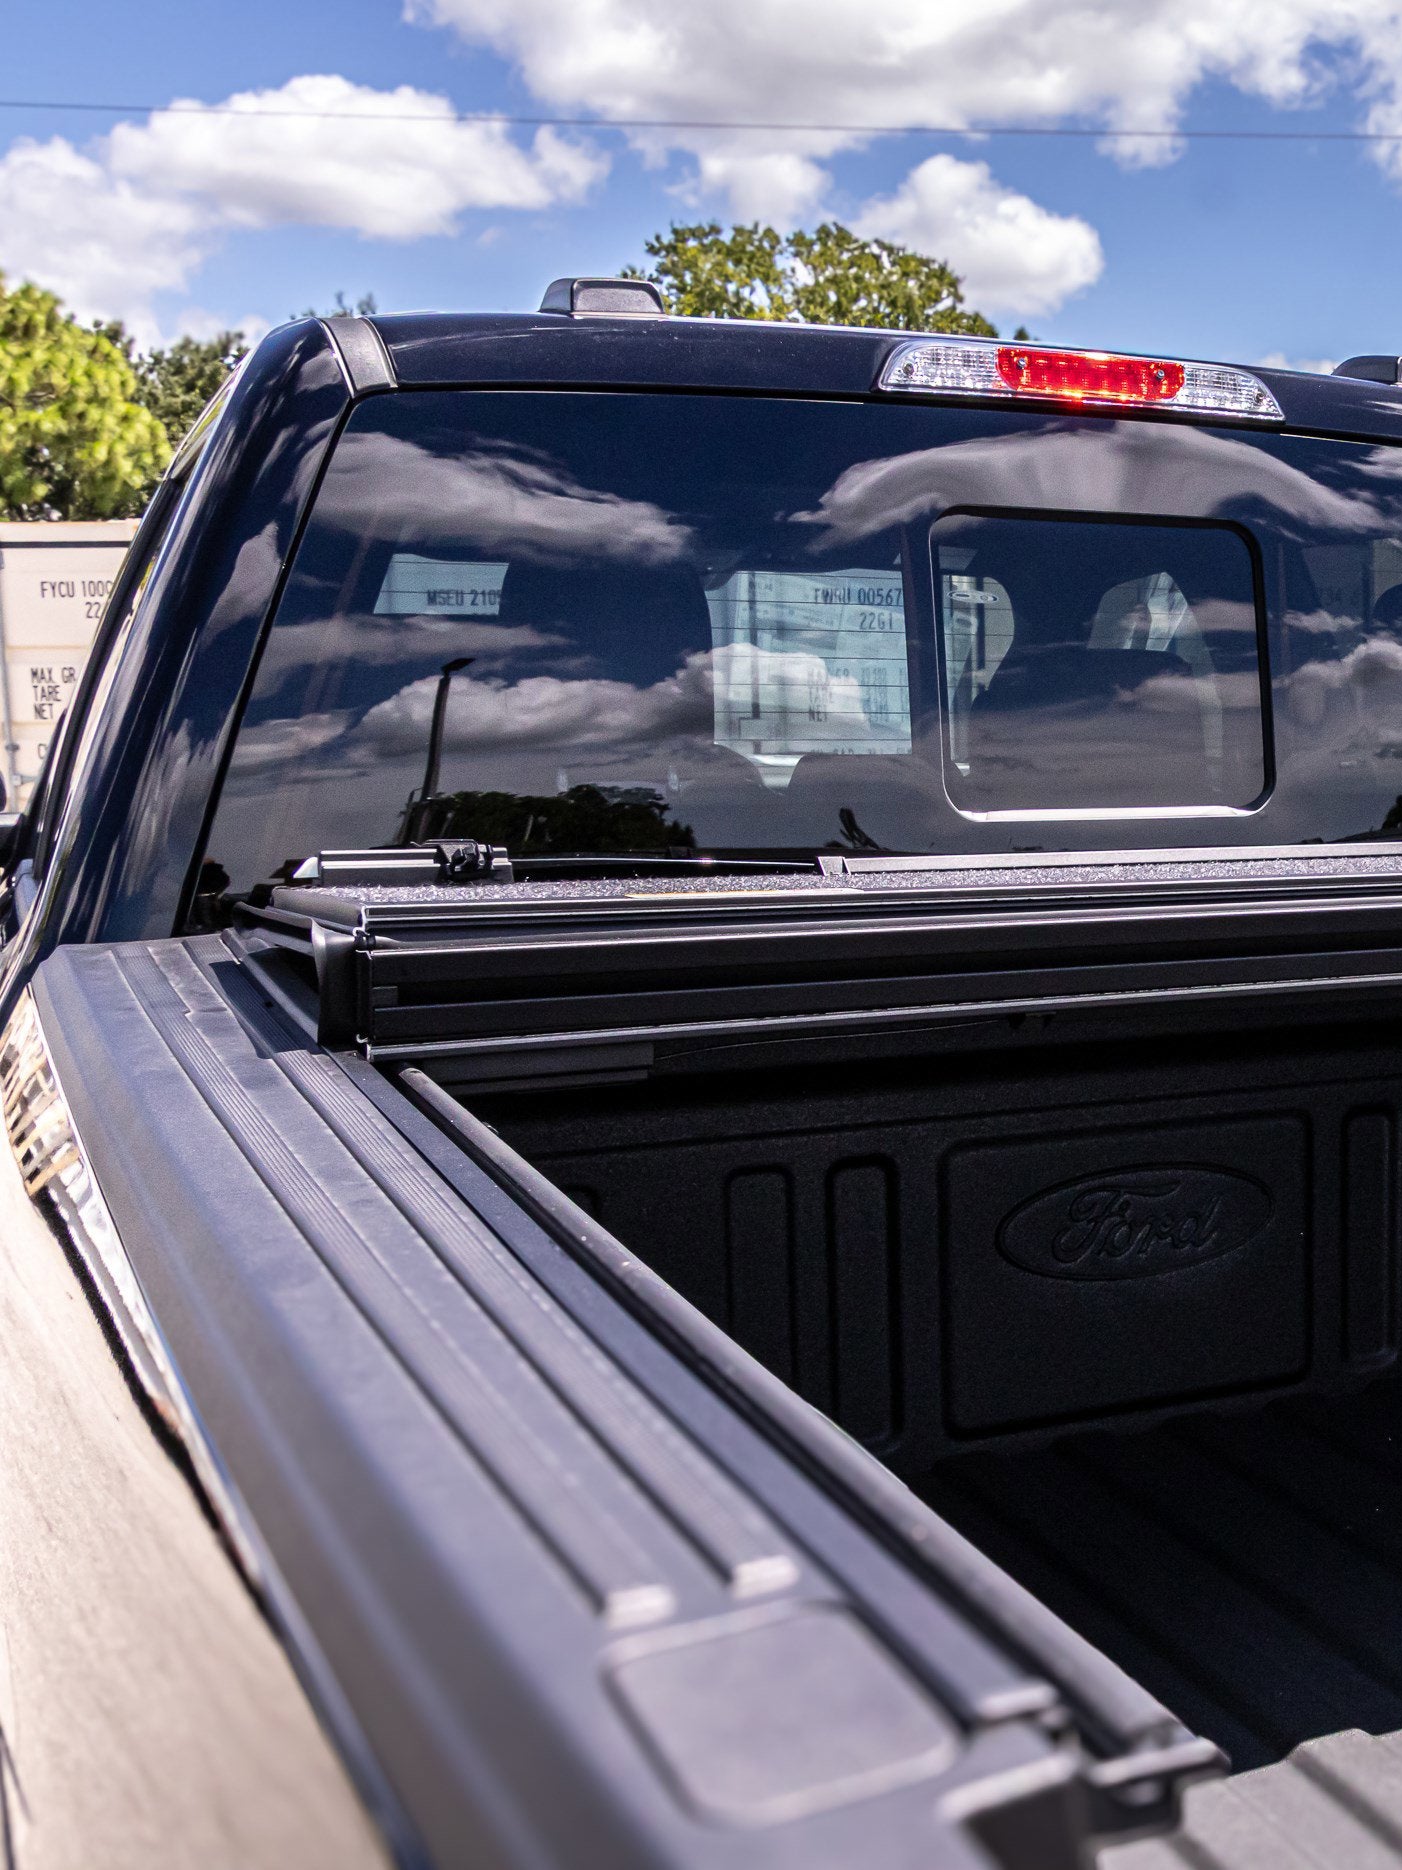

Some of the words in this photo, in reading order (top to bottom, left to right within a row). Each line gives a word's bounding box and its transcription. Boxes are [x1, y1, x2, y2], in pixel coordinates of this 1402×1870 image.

[40, 581, 75, 598] FYCU
[33, 685, 61, 702] TARE
[34, 703, 53, 720] NET
[1052, 1180, 1222, 1265] Ford
